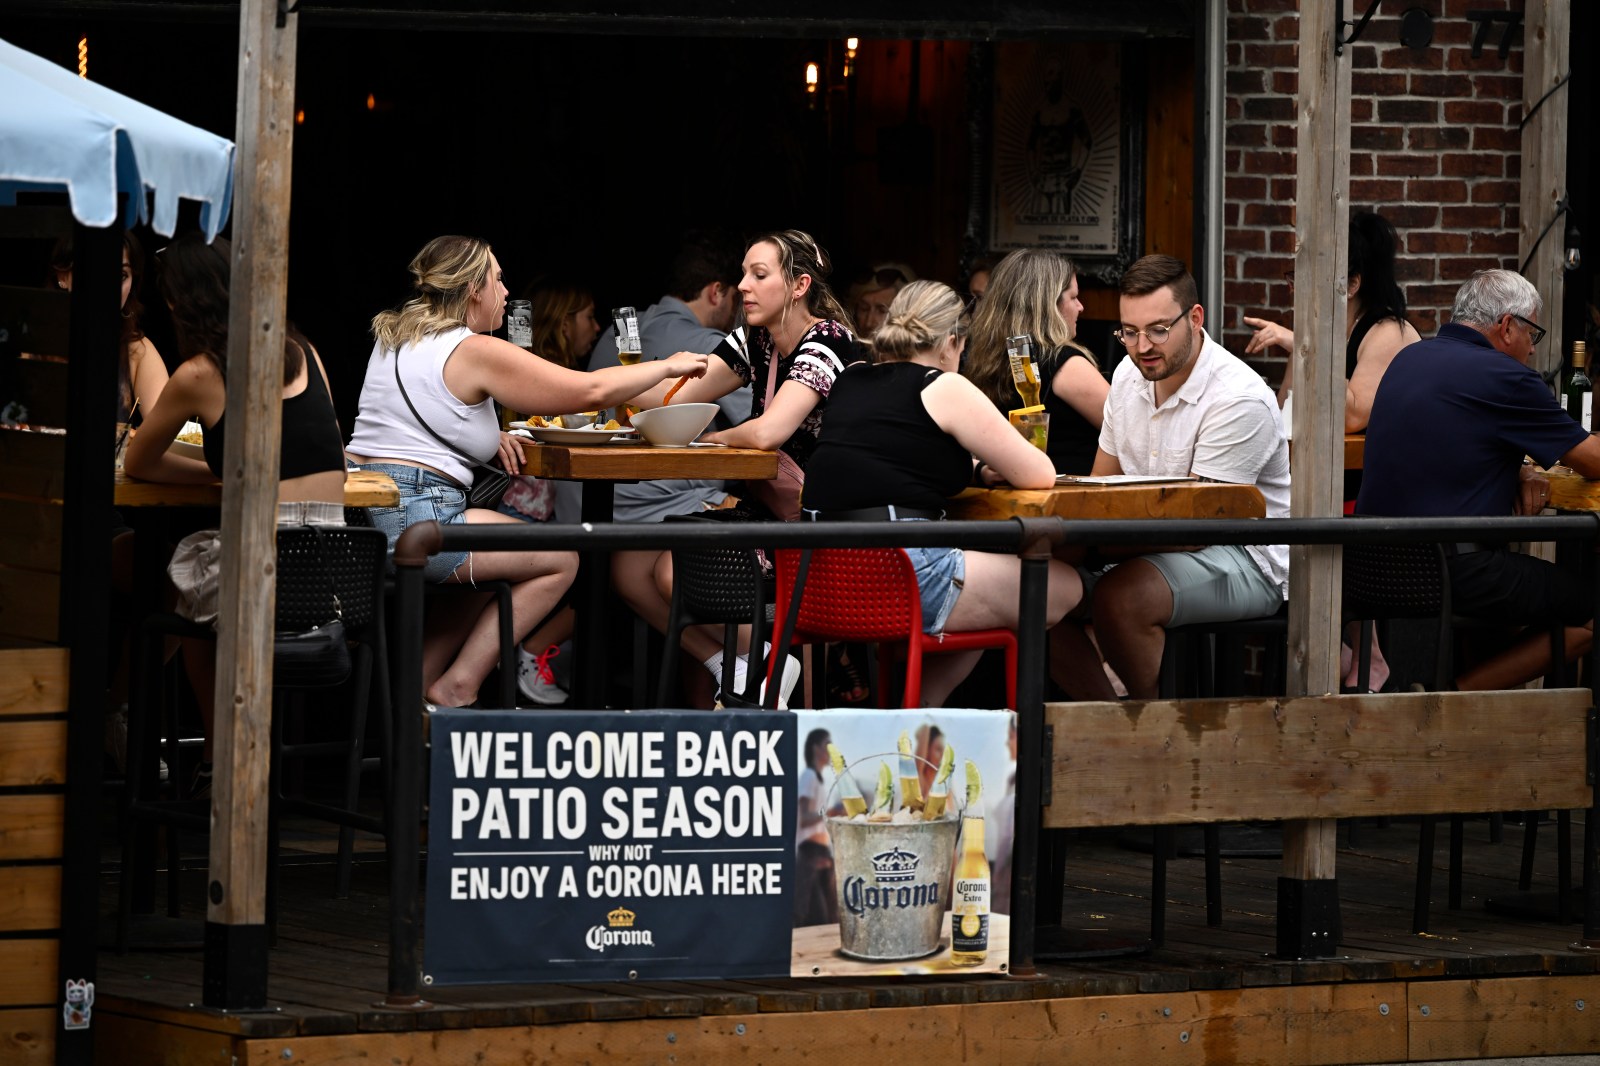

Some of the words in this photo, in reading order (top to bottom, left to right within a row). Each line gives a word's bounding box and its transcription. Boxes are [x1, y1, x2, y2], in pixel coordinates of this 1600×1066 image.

[1466, 10, 1525, 59] 77
[451, 731, 665, 779] WELCOME
[677, 730, 785, 777] BACK
[452, 787, 587, 840] PATIO
[602, 785, 783, 839] SEASON
[589, 845, 620, 862] WHY
[624, 844, 653, 861] NOT
[451, 866, 549, 900] ENJOY
[558, 866, 579, 898] A
[587, 864, 704, 898] CORONA
[712, 863, 782, 896] HERE
[843, 876, 939, 918] Corona
[957, 881, 987, 895] Corona
[964, 893, 982, 902] Extra
[585, 925, 654, 952] Corona
